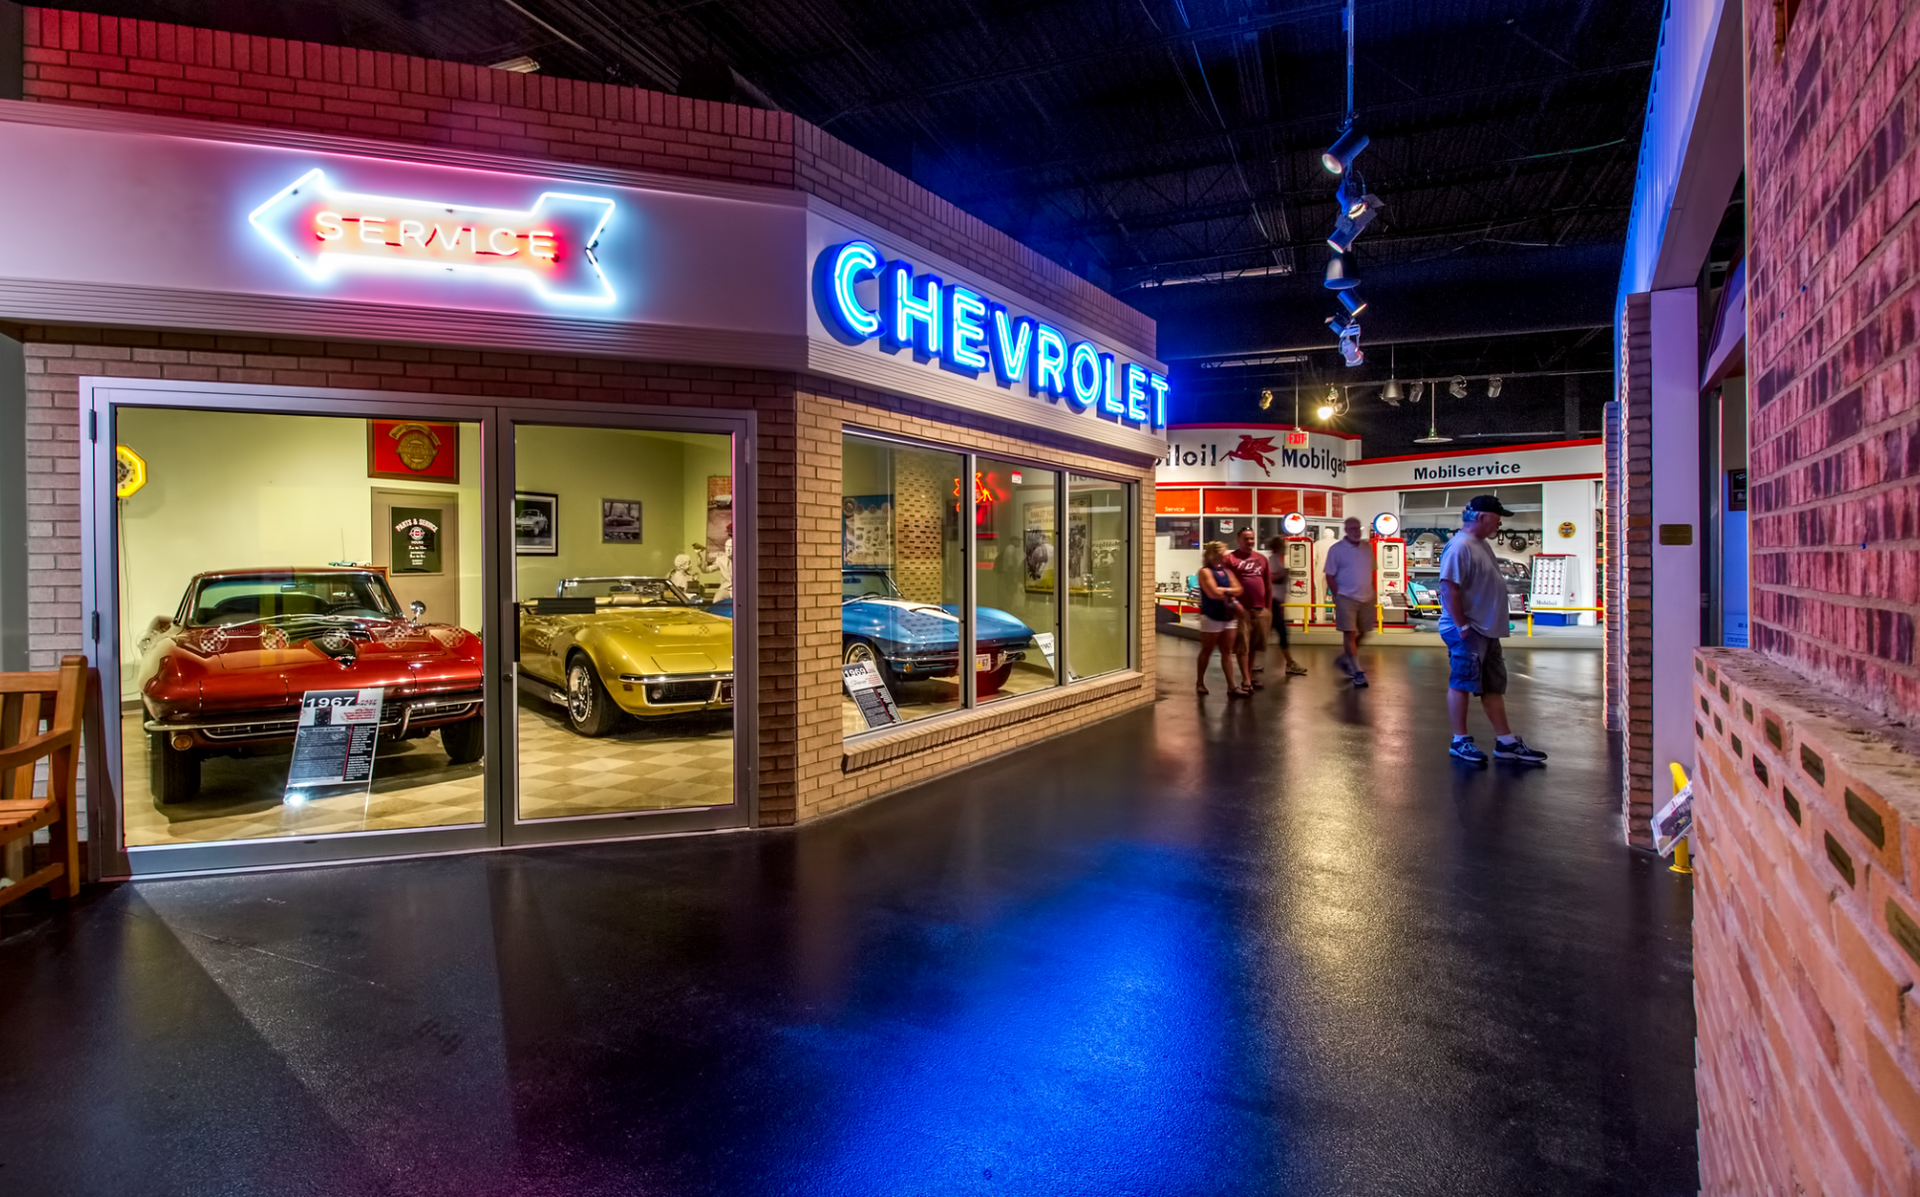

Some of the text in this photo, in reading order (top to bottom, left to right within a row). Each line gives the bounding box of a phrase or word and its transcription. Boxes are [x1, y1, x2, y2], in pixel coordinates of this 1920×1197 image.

[316, 211, 554, 258] SERVICE
[818, 238, 1172, 430] CHEVROLET
[1288, 433, 1306, 444] EXIT
[1282, 446, 1346, 477] Mobilgas
[1414, 461, 1521, 480] Mobilservice
[395, 519, 412, 532] PARTS
[844, 667, 865, 679] 1969
[307, 697, 355, 707] 1967
